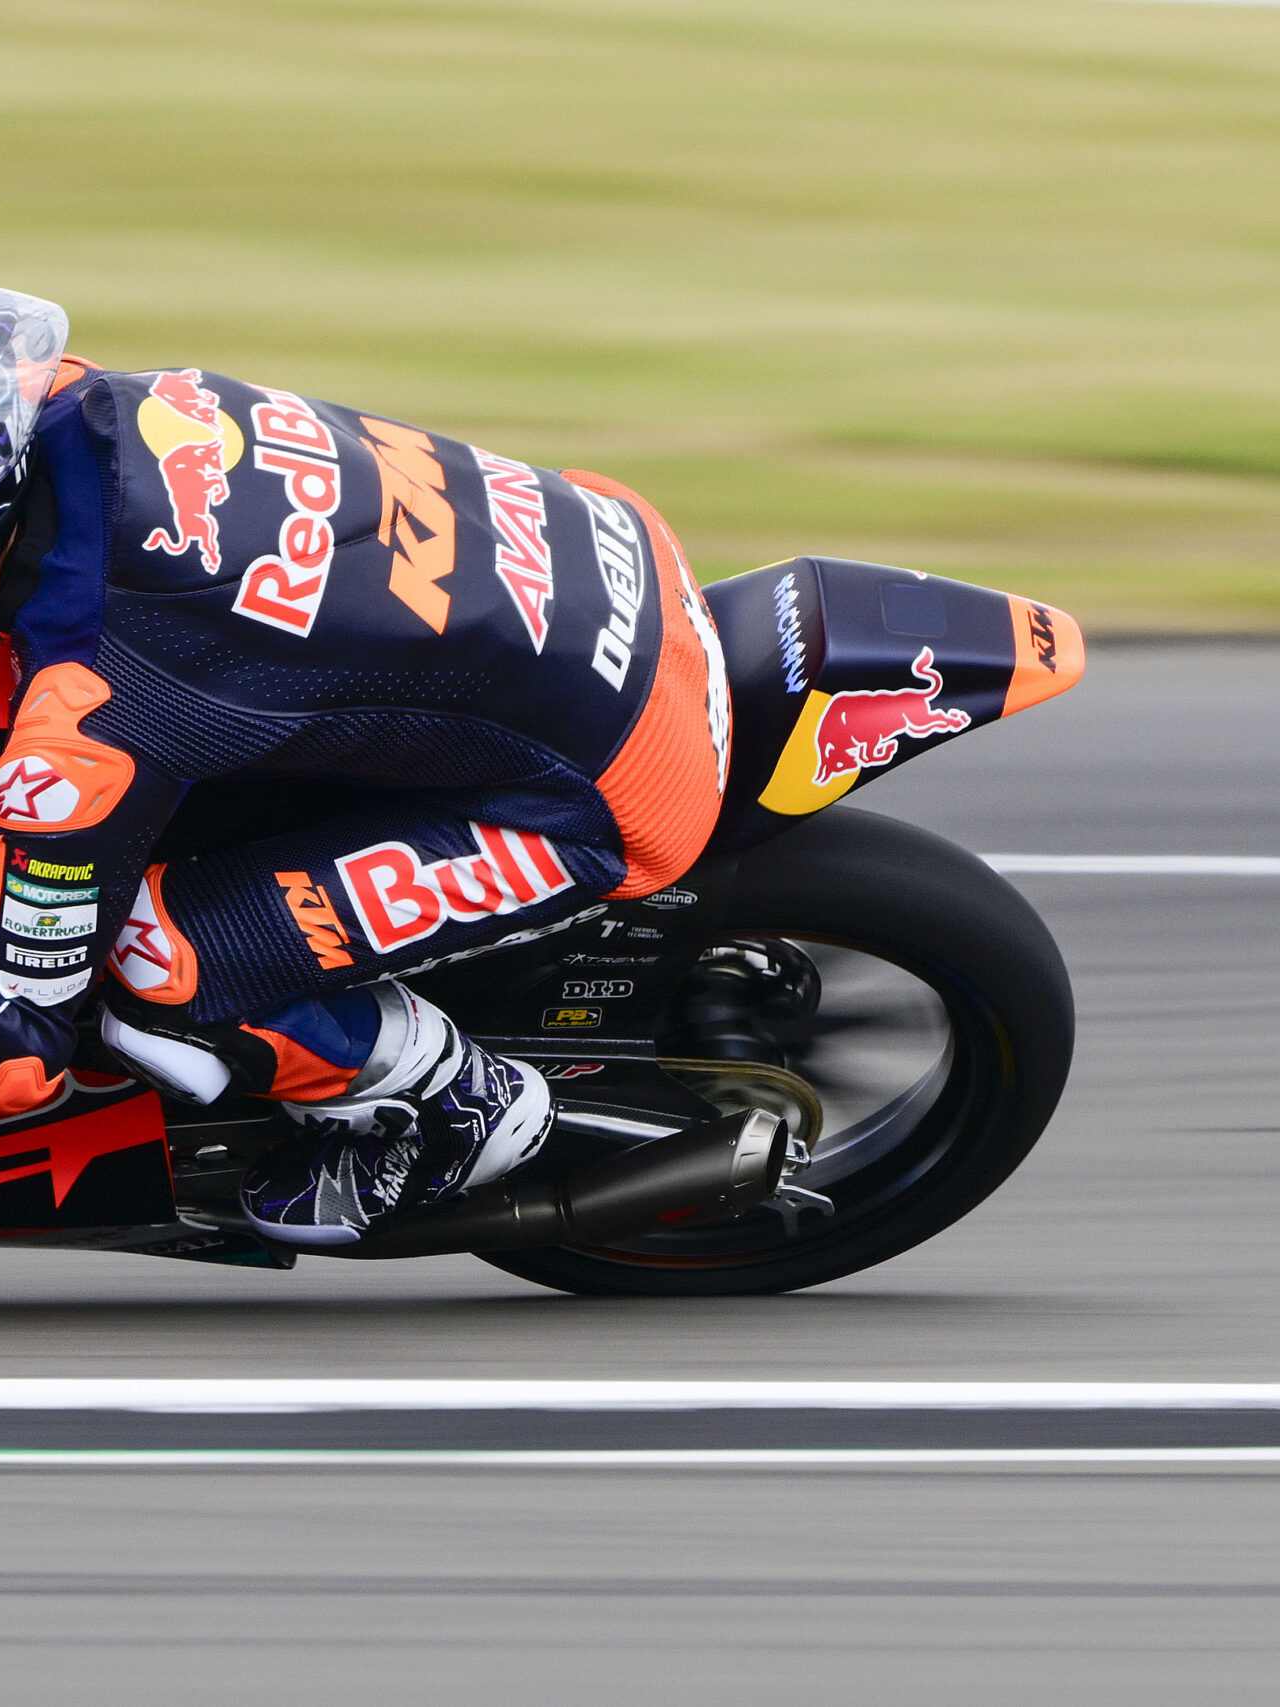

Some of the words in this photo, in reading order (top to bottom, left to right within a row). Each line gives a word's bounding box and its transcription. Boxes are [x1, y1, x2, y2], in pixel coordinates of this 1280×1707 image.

[358, 416, 457, 636] KTM
[1027, 602, 1057, 674] KTM
[22, 884, 97, 903] MOTOREX
[274, 871, 354, 970] KTM
[334, 821, 577, 954] Bull
[4, 917, 94, 938] FLOWERTRUCKS
[6, 943, 88, 969] PIRELLI
